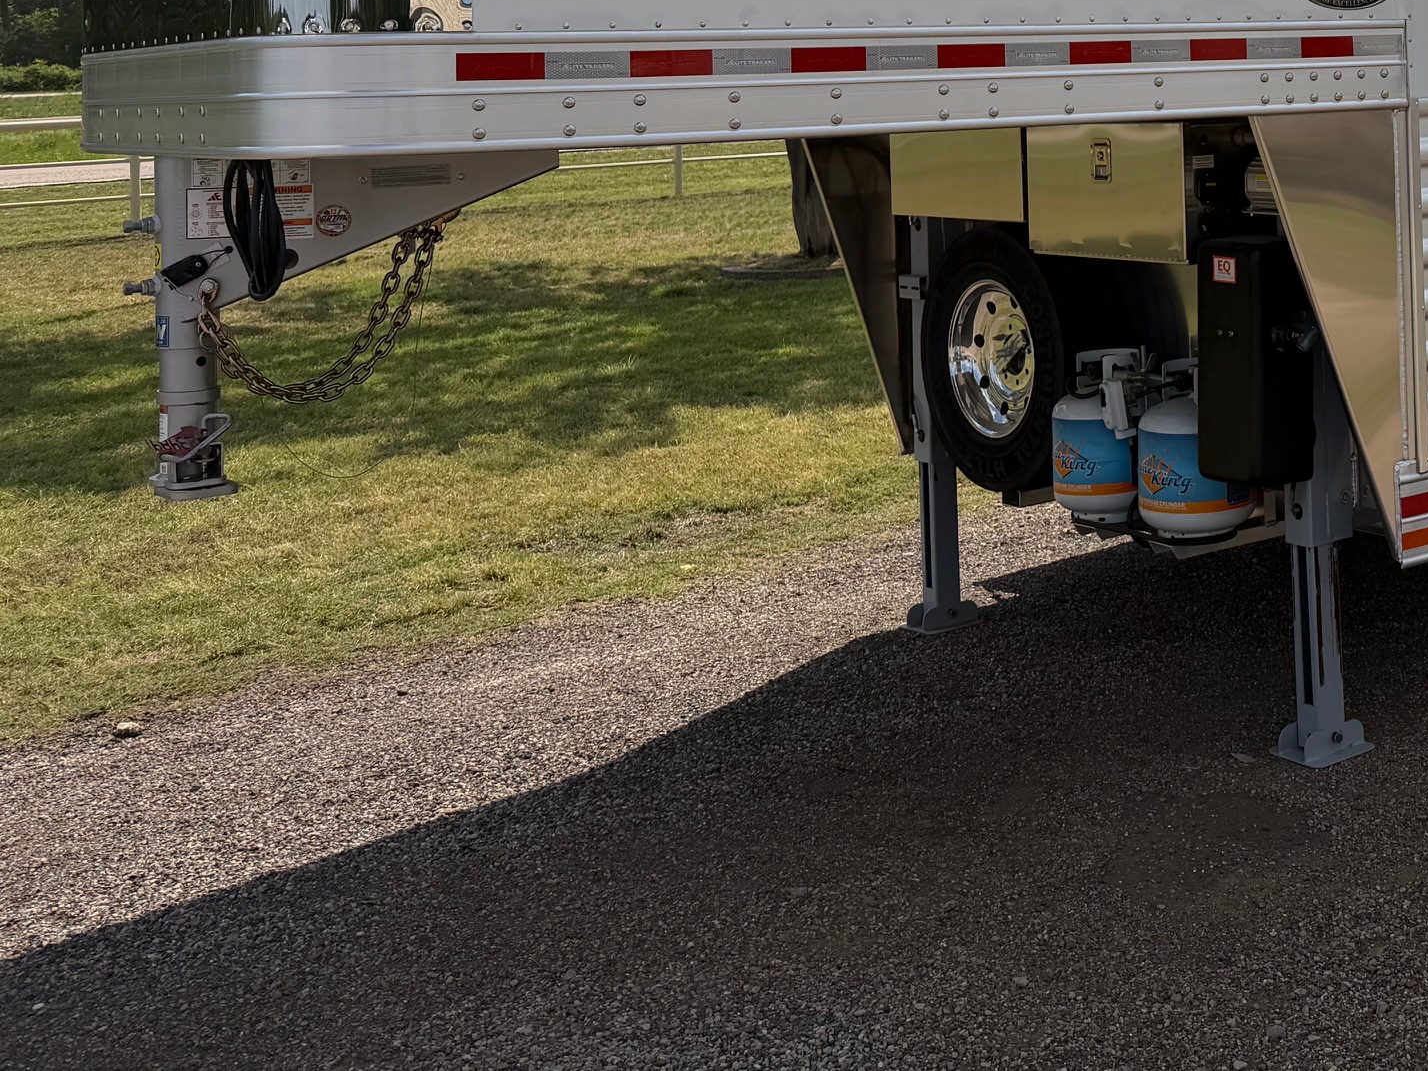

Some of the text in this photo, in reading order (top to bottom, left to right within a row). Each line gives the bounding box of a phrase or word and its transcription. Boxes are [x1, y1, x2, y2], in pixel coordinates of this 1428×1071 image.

[274, 186, 303, 194] RNING
[1217, 259, 1231, 276] EQ
[1061, 457, 1098, 477] King
[1151, 470, 1193, 495] King
[1159, 500, 1187, 508] CYLINDER
